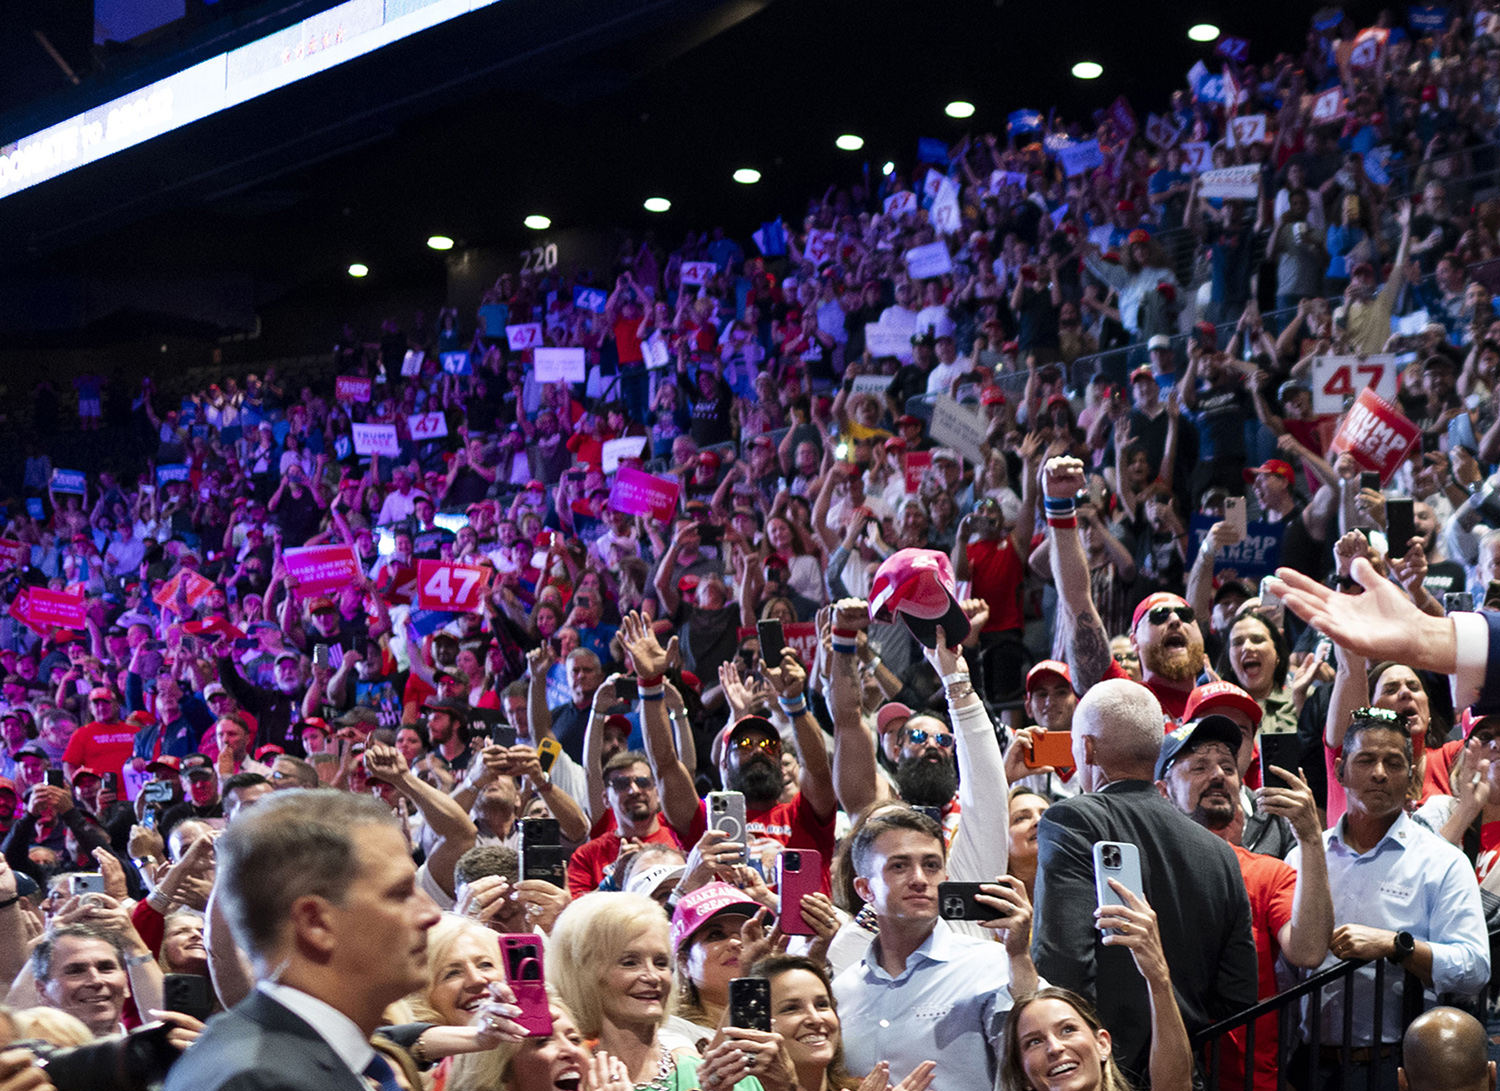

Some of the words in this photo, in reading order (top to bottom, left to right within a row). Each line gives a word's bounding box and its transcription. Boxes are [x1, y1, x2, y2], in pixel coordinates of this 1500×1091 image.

[520, 243, 558, 275] 220
[514, 328, 536, 344] 47
[444, 354, 466, 374] 47
[1322, 364, 1385, 396] 47
[415, 417, 439, 432] 47
[1352, 402, 1408, 451] TRUMP
[1345, 416, 1393, 460] VANCE
[1195, 528, 1277, 550] TMP
[1217, 546, 1266, 561] ANCE
[291, 564, 316, 576] MAKE
[424, 566, 481, 604] 47
[1200, 681, 1248, 698] TRUMP
[685, 887, 718, 908] MAKE
[696, 898, 732, 916] GREAT
